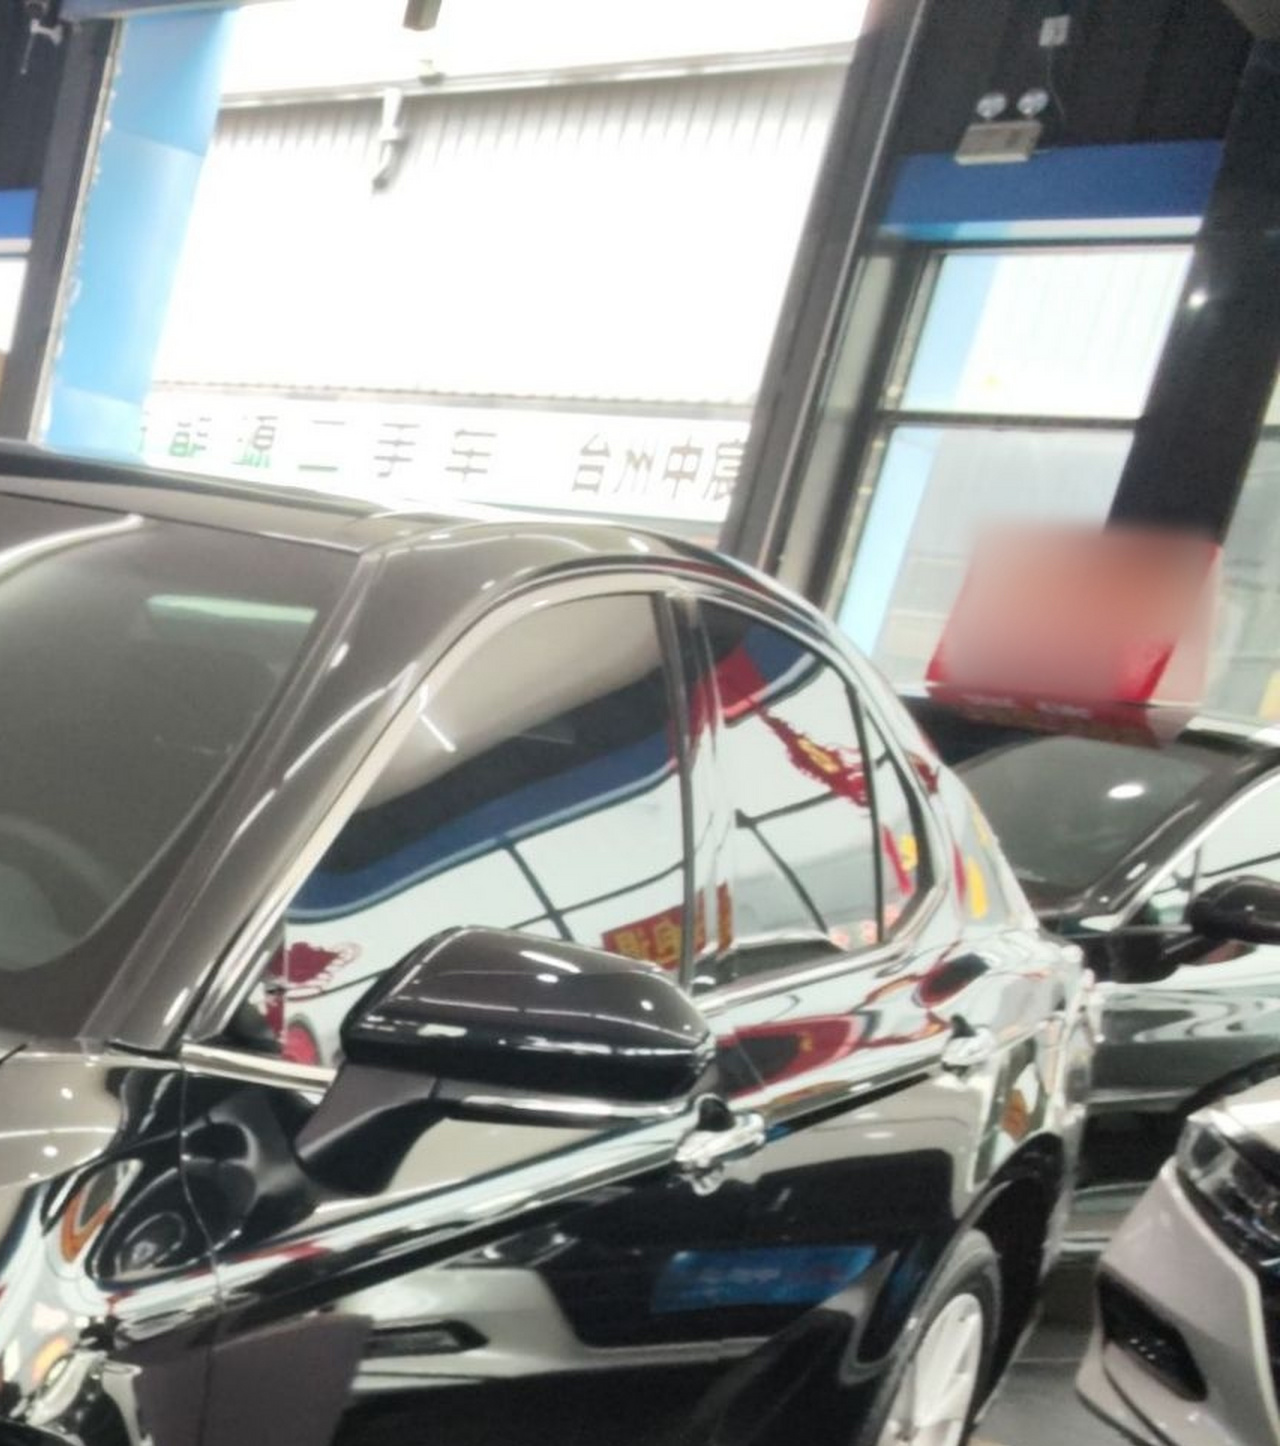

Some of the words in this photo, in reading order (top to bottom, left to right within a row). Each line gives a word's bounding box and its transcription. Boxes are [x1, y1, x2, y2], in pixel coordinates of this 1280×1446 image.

[138, 411, 497, 483] 能源二手车
